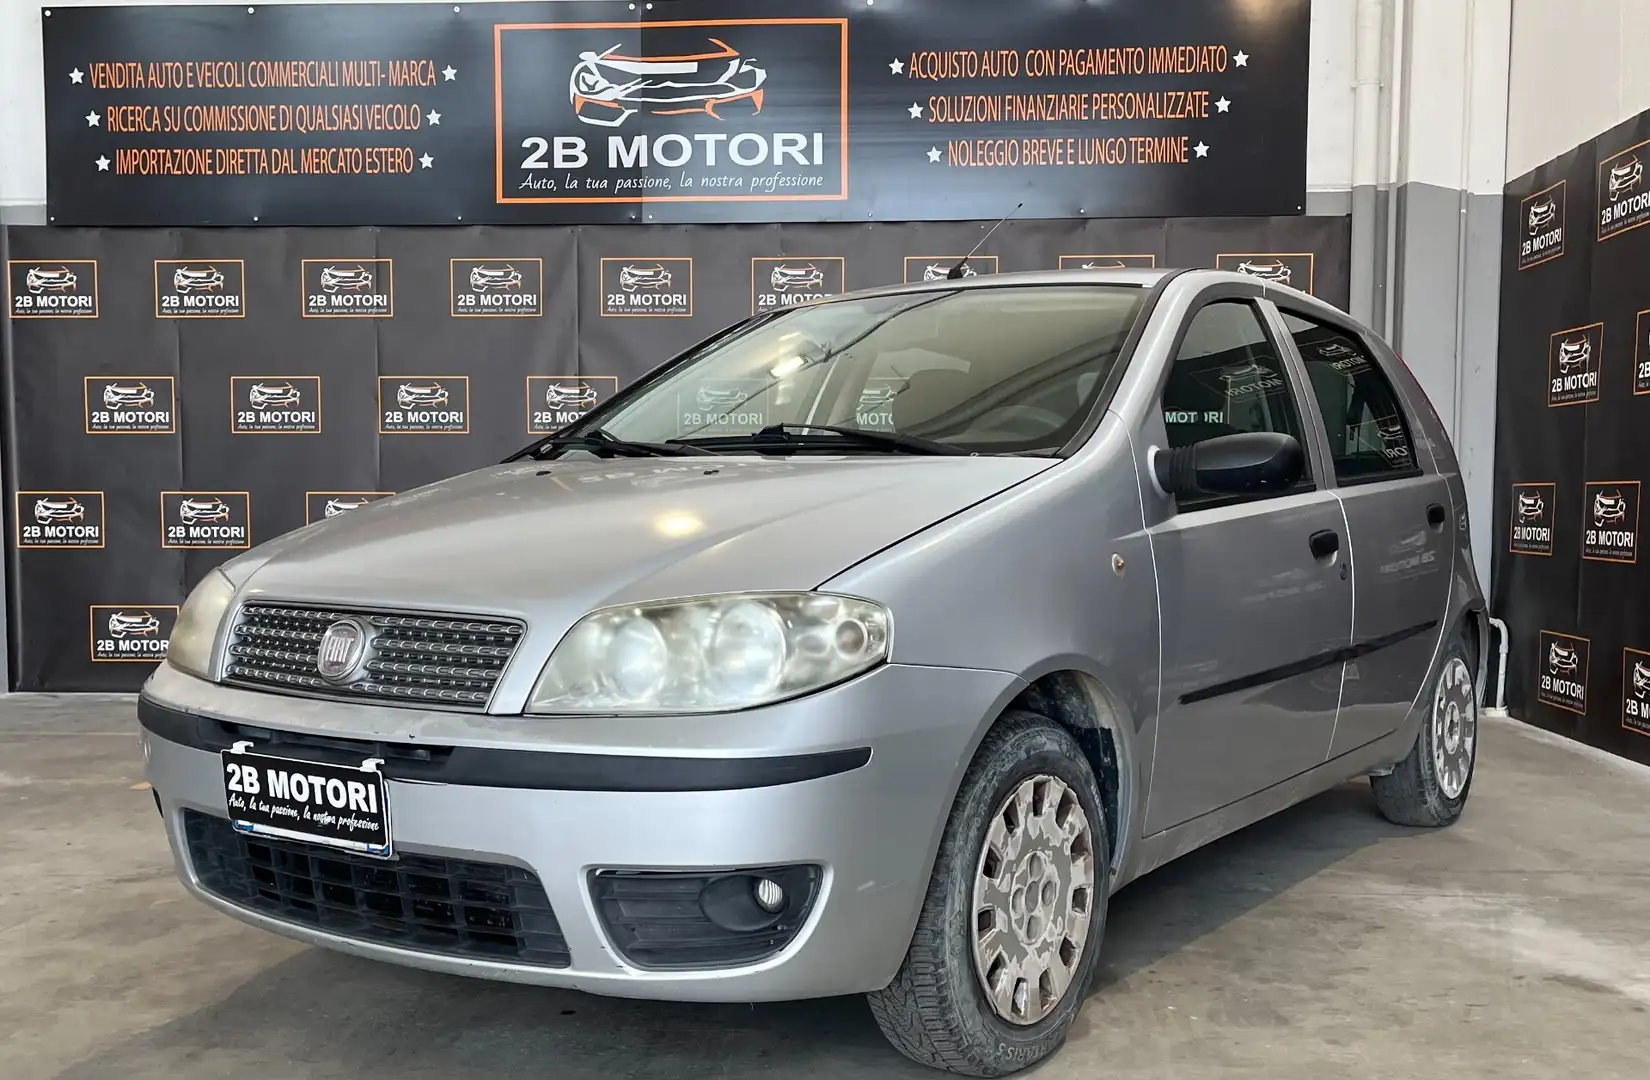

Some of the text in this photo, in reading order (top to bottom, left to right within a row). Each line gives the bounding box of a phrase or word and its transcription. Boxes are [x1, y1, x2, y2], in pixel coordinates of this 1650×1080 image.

[909, 45, 1227, 81] ACQUISTO AUTO CON PAGAMENTO IMMEDIATO
[89, 60, 436, 89] VENDITA AUTO E VEICOLI COMMERCIALI MULTI- MARCA
[928, 91, 1209, 123] SOLUZIONI FINANZIARIE PERSONALIZZATE
[107, 104, 421, 134] RICERCA SU COMMISSIONE DI QUALSIASI VEICOLO
[520, 132, 823, 169] 2B MOTORI
[948, 136, 1189, 167] NOLEGGIO BREVE E LUNGO TERMINE
[116, 147, 414, 175] IMPORTAZIONE DIRETTA DAL MERCATO ESTERO
[519, 171, 823, 194] Auto, la tua passione, la nostra professione
[1602, 207, 1612, 225] 2B
[1522, 240, 1531, 256] 2B
[1533, 228, 1561, 251] MOTORI
[15, 296, 92, 307] 2B MOTORI
[162, 295, 239, 306] 2B MOTORI
[309, 294, 387, 306] 2B MOTORI
[457, 294, 536, 305] 2B MOTORI
[607, 294, 686, 305] 2B MOTORI
[758, 294, 776, 305] 2B
[1552, 372, 1597, 392] 2B MOTORI
[92, 412, 169, 423] 2B MOTORI
[238, 412, 315, 423] 2B MOTORI
[385, 412, 463, 423] 2B MOTORI
[533, 412, 552, 423] 2B
[684, 413, 762, 425] 2B MOTORI
[23, 526, 99, 537] 2B MOTORI
[168, 526, 245, 538] 2B MOTORI
[1521, 527, 1550, 541] MOTORI
[1586, 530, 1633, 547] 2B MOTORI
[97, 640, 115, 651] 2B
[1541, 675, 1551, 690] 2B
[1553, 678, 1584, 700] MOTORI
[1626, 698, 1638, 716] 2B
[226, 763, 378, 813] 2B MOTORI
[228, 793, 246, 811] Auto,
[249, 796, 257, 810] la
[258, 801, 270, 813] tua
[271, 805, 300, 821] passione,
[303, 805, 311, 820] la
[337, 813, 380, 832] professione
